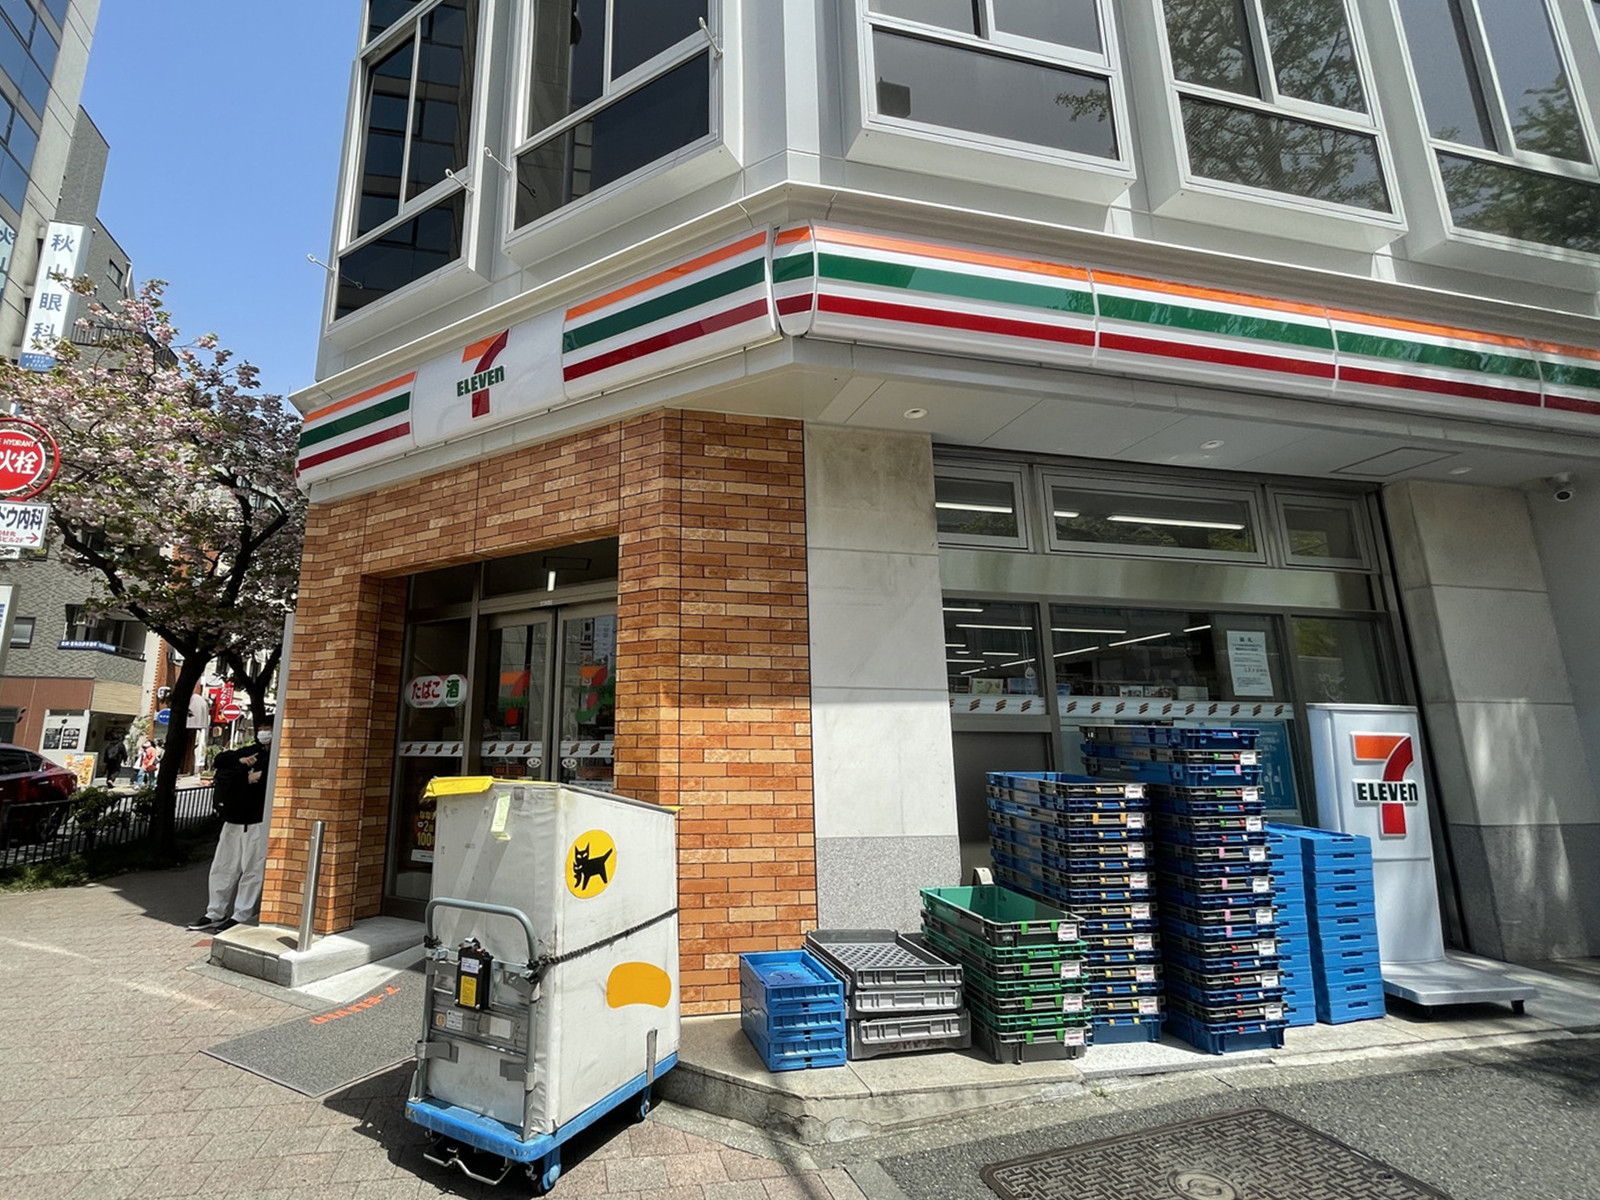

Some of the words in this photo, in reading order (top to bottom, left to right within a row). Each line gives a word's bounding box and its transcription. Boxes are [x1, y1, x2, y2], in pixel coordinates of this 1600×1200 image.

[32, 233, 74, 343] 秋山眼科
[462, 328, 509, 418] 7
[3, 438, 35, 447] HYDRANT
[411, 680, 441, 700] たばこ
[445, 679, 460, 698] 酒
[1352, 733, 1414, 835] 7
